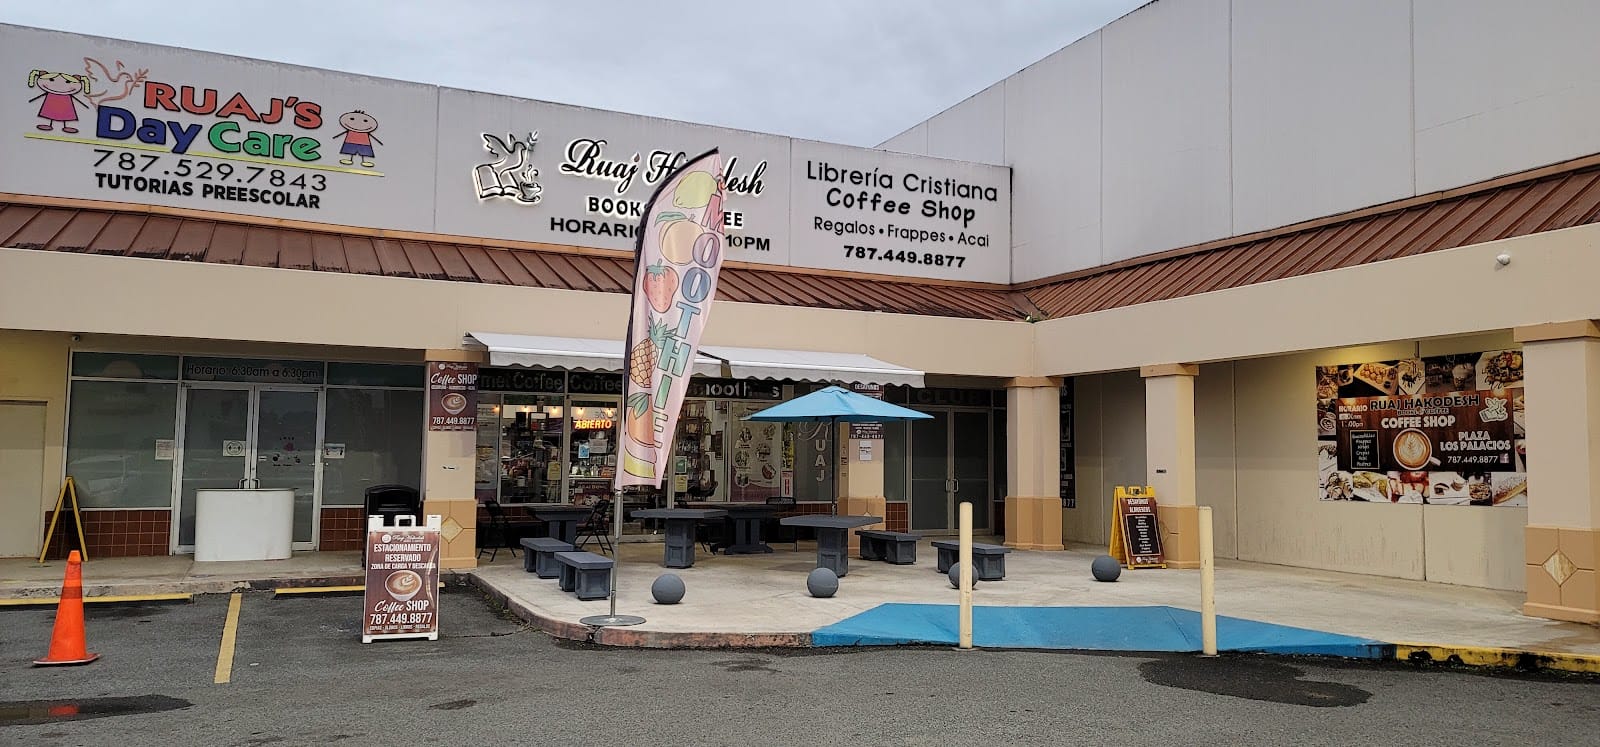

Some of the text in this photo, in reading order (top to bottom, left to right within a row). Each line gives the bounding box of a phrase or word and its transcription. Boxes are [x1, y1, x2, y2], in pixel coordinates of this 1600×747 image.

[144, 81, 323, 129] RUAJ'S
[96, 105, 322, 161] Day Care
[93, 149, 327, 191] 787.529.7843
[561, 138, 639, 193] Ruaj
[807, 160, 998, 201] Librería Cristiana
[95, 173, 320, 209] TUTORIAS PREESCOLAR
[588, 196, 649, 217] BOOK
[826, 187, 976, 228] Coffee Shop
[814, 216, 989, 248] Regalos Frappes Acai
[843, 245, 966, 268] 787.449.8877
[431, 372, 477, 384] Coffee SHOP
[1404, 395, 1480, 409] HAKODESH
[575, 419, 613, 430] ABIERTO
[1381, 415, 1456, 429] COFFEE SHOP
[1458, 431, 1490, 441] PLAZA
[1440, 440, 1511, 451] LOS PALACIOS
[1447, 456, 1499, 464] 787.449.8877
[374, 543, 431, 552] ESTACIONAMIENTO
[385, 553, 421, 562] RESERVADO
[375, 600, 429, 613] Coffee SHOP
[370, 612, 432, 625] 787.449.8877
